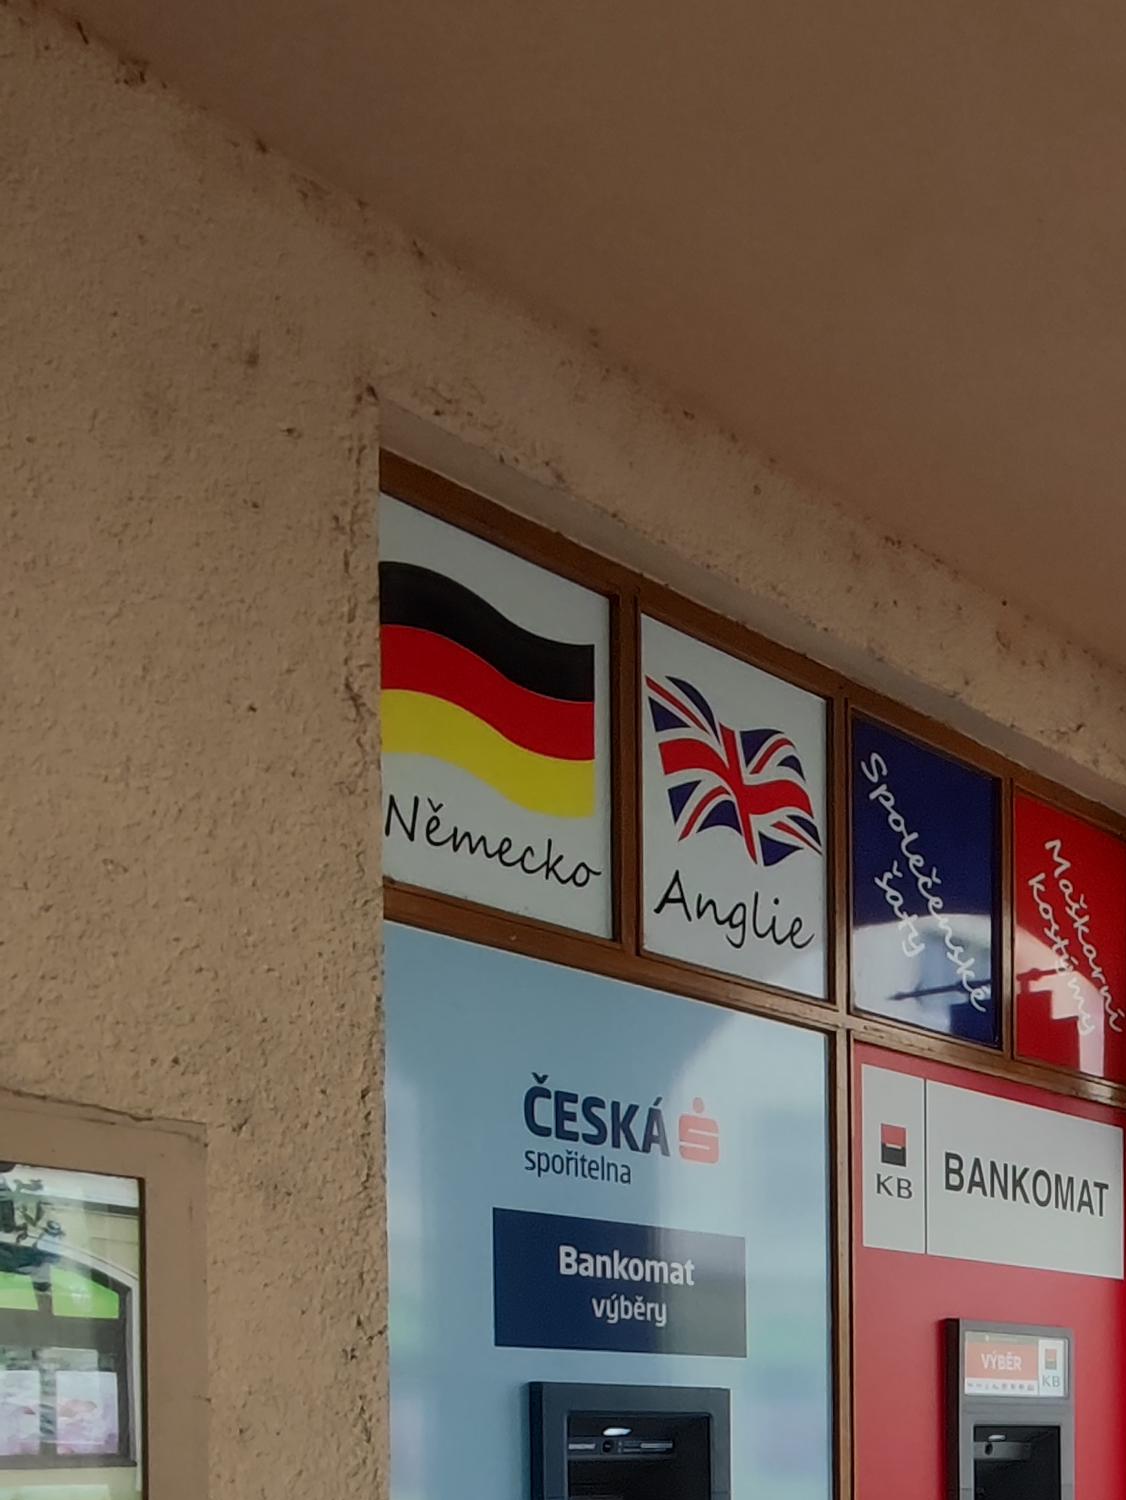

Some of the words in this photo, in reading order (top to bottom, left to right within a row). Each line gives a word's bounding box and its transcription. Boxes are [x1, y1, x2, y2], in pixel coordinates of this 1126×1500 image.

[384, 795, 602, 888] Německo
[653, 869, 816, 949] Anglie
[861, 752, 986, 1013] Společenské
[1045, 839, 1126, 1033] Maškarní
[523, 1071, 671, 1157] ČESKÁ
[524, 1150, 632, 1185] spořitelna
[876, 1173, 913, 1200] KB
[944, 1151, 1109, 1217] BANKOMAT
[558, 1244, 696, 1286] Bankomat
[592, 1293, 667, 1328] výběry
[1042, 1375, 1061, 1388] KB
